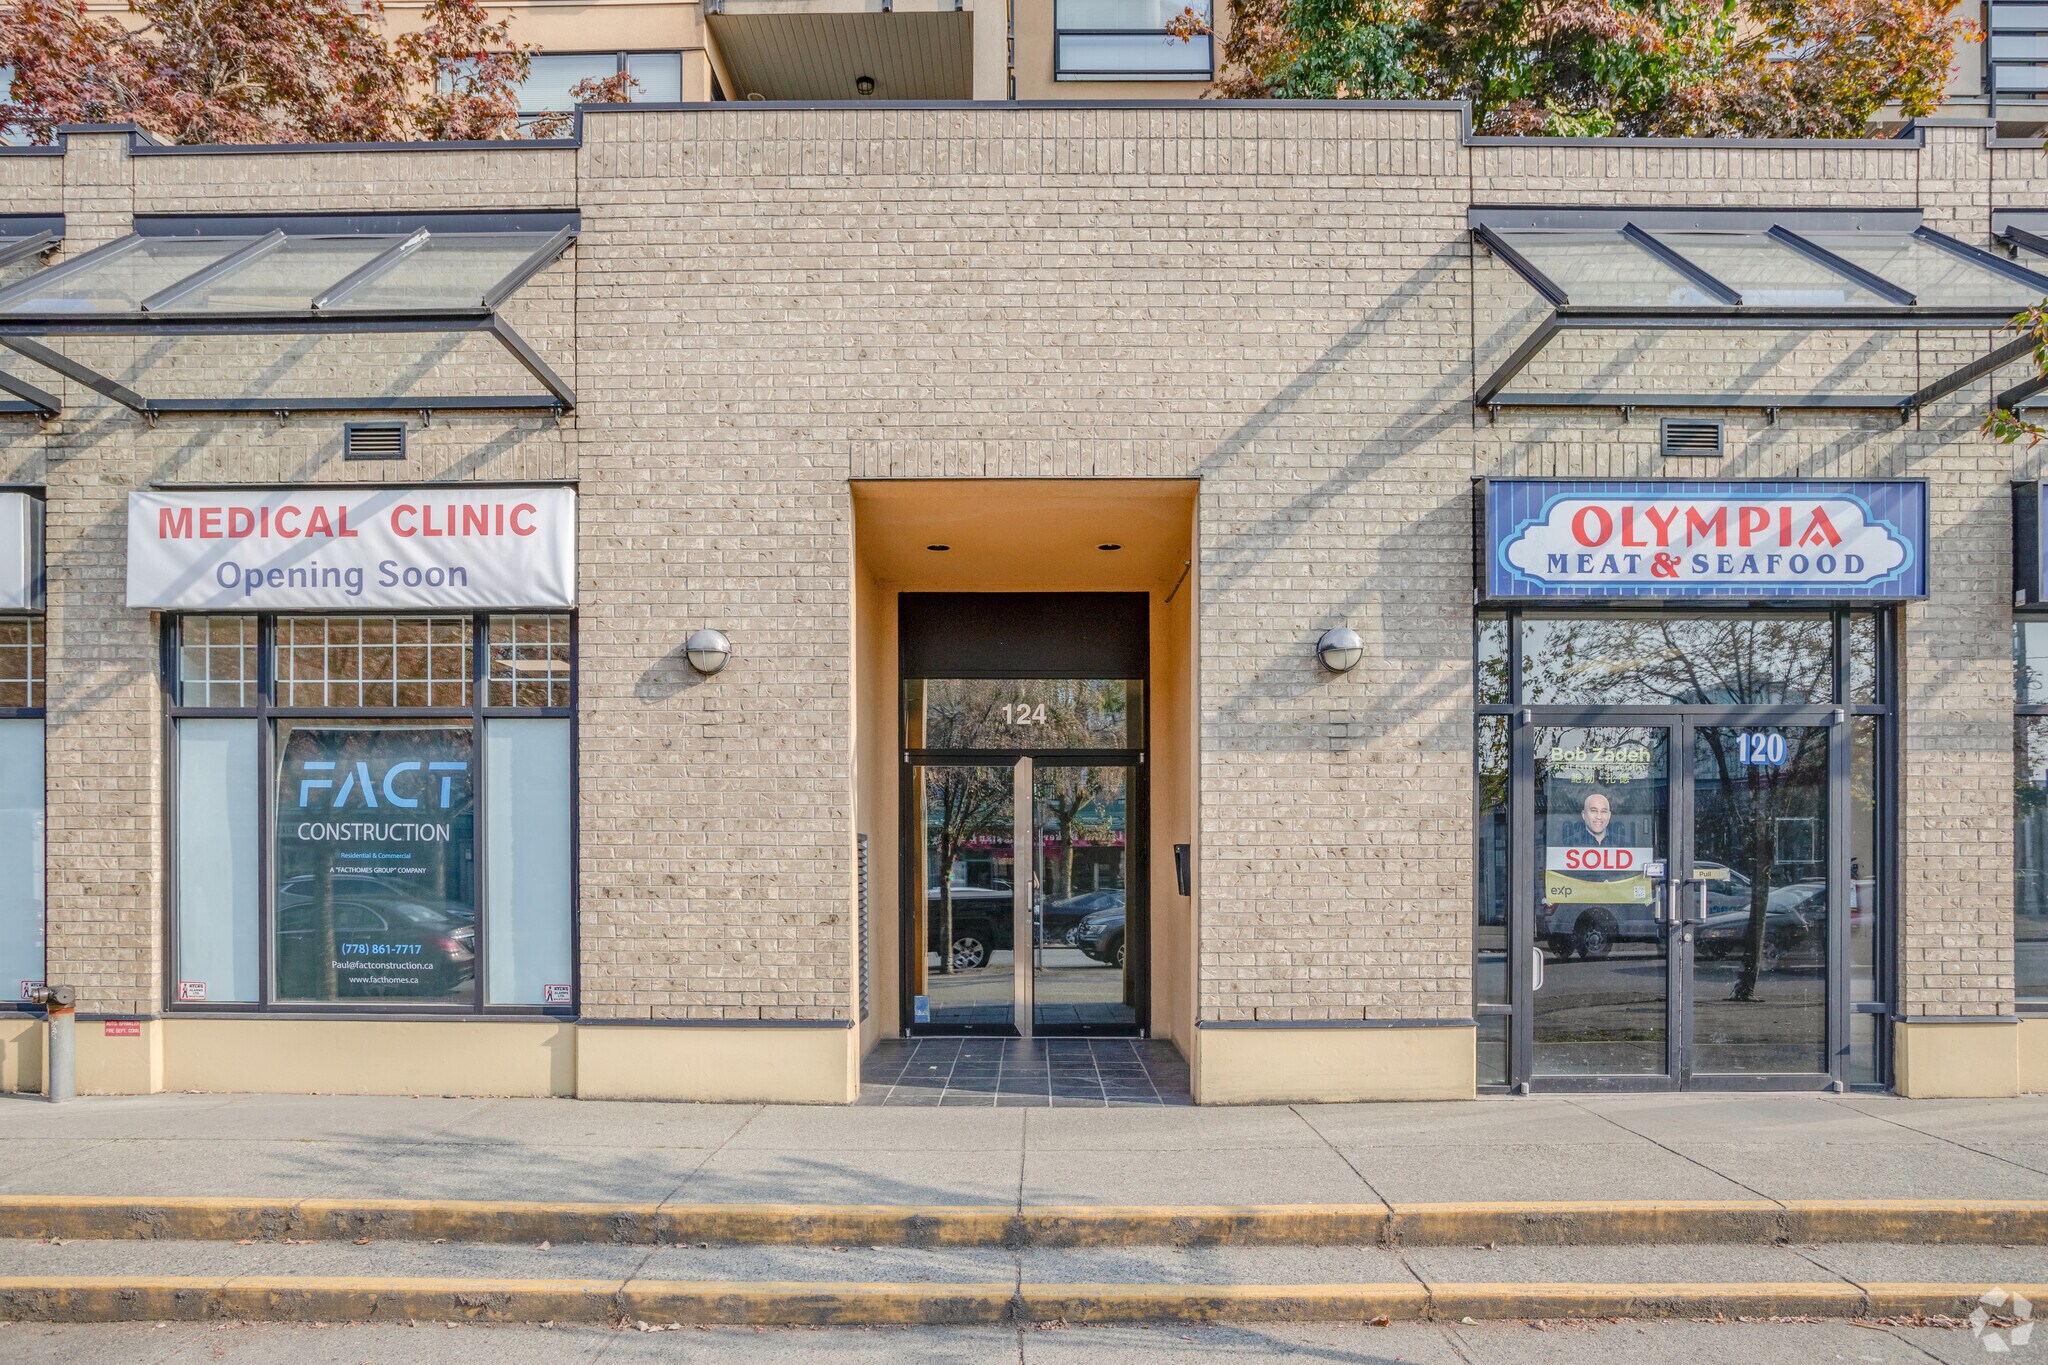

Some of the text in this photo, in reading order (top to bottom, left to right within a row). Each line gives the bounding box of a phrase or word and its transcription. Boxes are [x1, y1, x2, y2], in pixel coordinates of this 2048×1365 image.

[159, 503, 537, 539] MEDICAL CLINIC
[1571, 505, 1843, 548] OLYMPIA
[1547, 552, 1865, 578] MEAT & SEAFOOD
[216, 559, 468, 596] Opening Soon
[1002, 703, 1047, 725] 124
[1551, 747, 1651, 761] Bob Zadeh
[1736, 733, 1787, 765] 120
[299, 761, 468, 809] FACT
[297, 822, 450, 842] CONSTRUCTION
[1566, 849, 1633, 870] SOLD
[1550, 886, 1573, 898] exp
[342, 943, 421, 955] (778) 861-7717
[332, 961, 433, 970] Paul@factconstruction.ca
[349, 976, 419, 984] www.facthomes.ca
